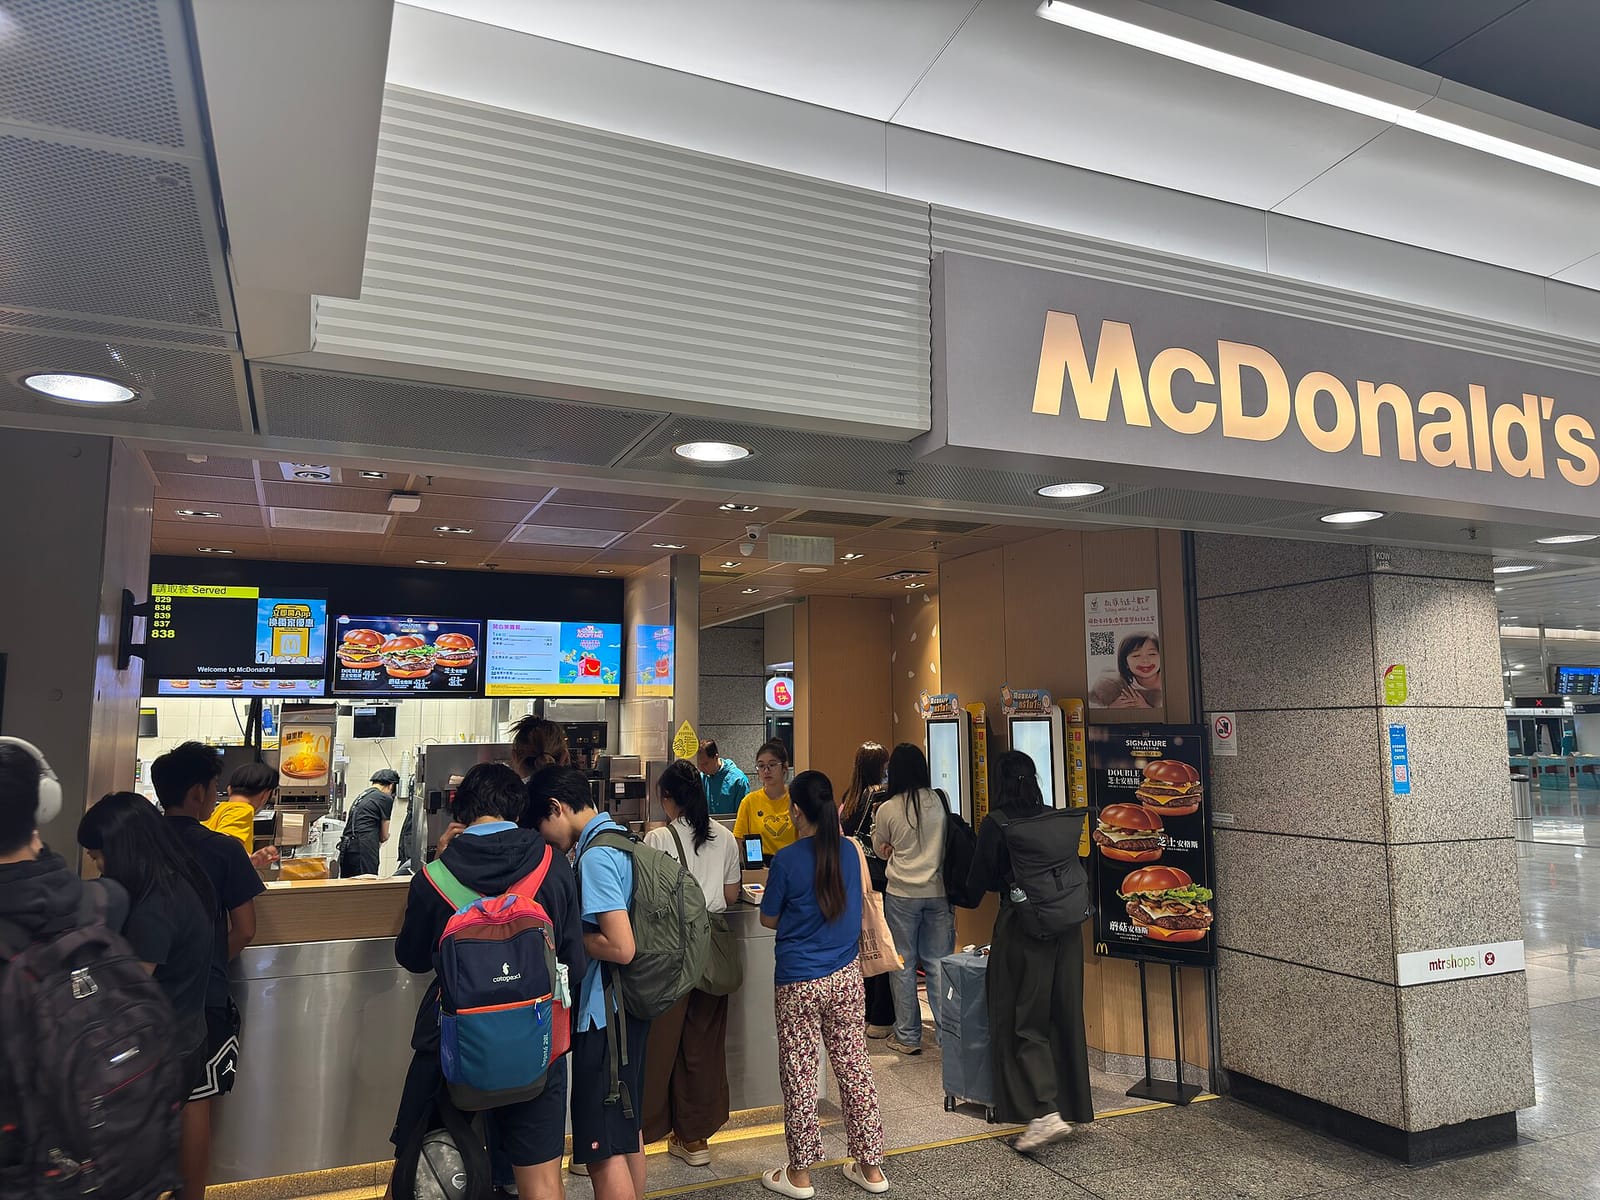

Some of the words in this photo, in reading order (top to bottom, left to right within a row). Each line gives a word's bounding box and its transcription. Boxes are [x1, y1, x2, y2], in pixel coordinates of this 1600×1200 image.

[1032, 309, 1600, 486] McDonald's
[192, 586, 227, 595] Served
[153, 620, 171, 628] 837
[151, 629, 176, 639] 838
[1125, 739, 1167, 748] SIGNATURE
[1107, 768, 1141, 777] DOUBLE
